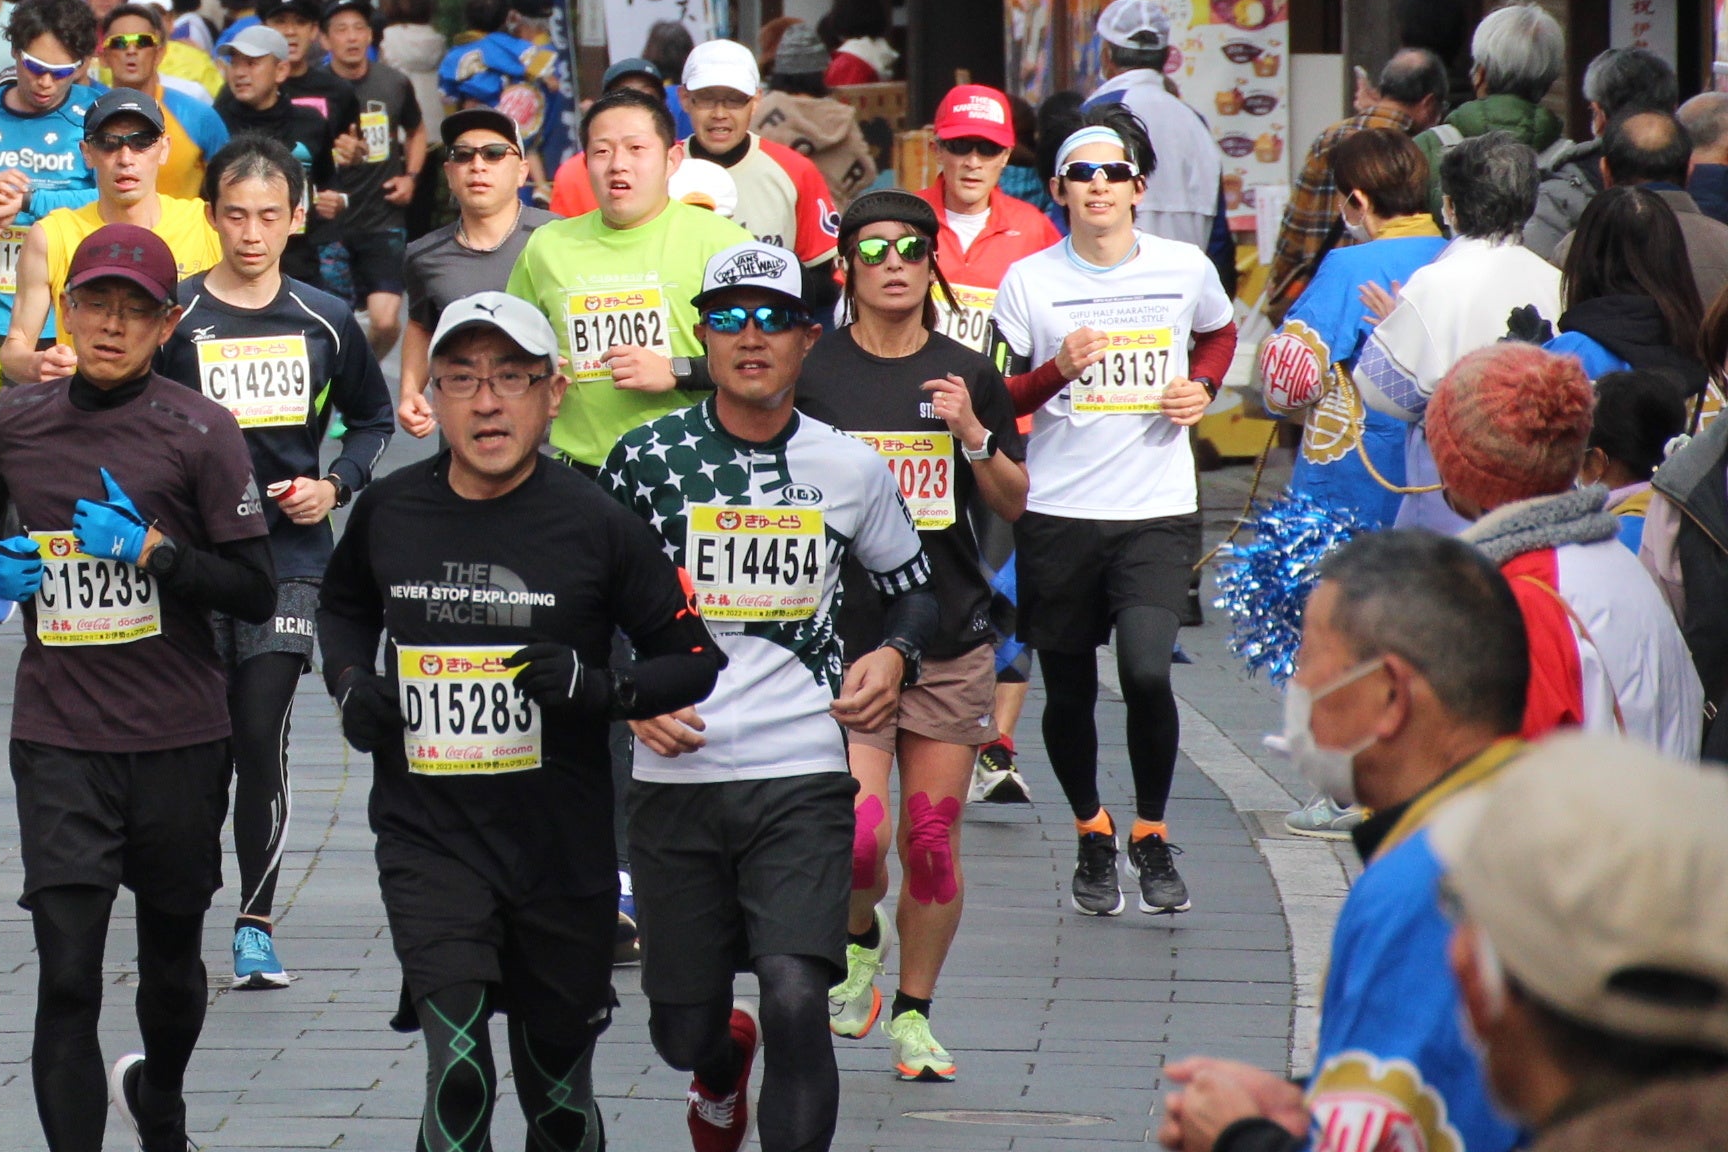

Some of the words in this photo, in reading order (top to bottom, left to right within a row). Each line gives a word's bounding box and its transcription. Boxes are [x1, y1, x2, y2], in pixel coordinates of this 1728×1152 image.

[1069, 310, 1091, 320] GIFU
[1093, 308, 1114, 318] HALF
[1117, 305, 1169, 316] MARATHON
[1099, 317, 1139, 326] NORMAL
[1141, 314, 1164, 323] STYLE
[574, 310, 664, 352] B12062
[209, 359, 305, 400] C14239
[916, 509, 949, 517] docomo
[697, 536, 819, 585] E14454
[442, 561, 489, 584] THE
[40, 560, 152, 609] C15235
[390, 585, 429, 599] NEVER
[431, 586, 470, 602] STOP
[472, 589, 556, 607] EXPLORING
[780, 596, 815, 606] docomo
[117, 613, 154, 627] docomo
[426, 601, 486, 625] FACE
[406, 681, 533, 735] D15283
[491, 744, 534, 757] docomo
